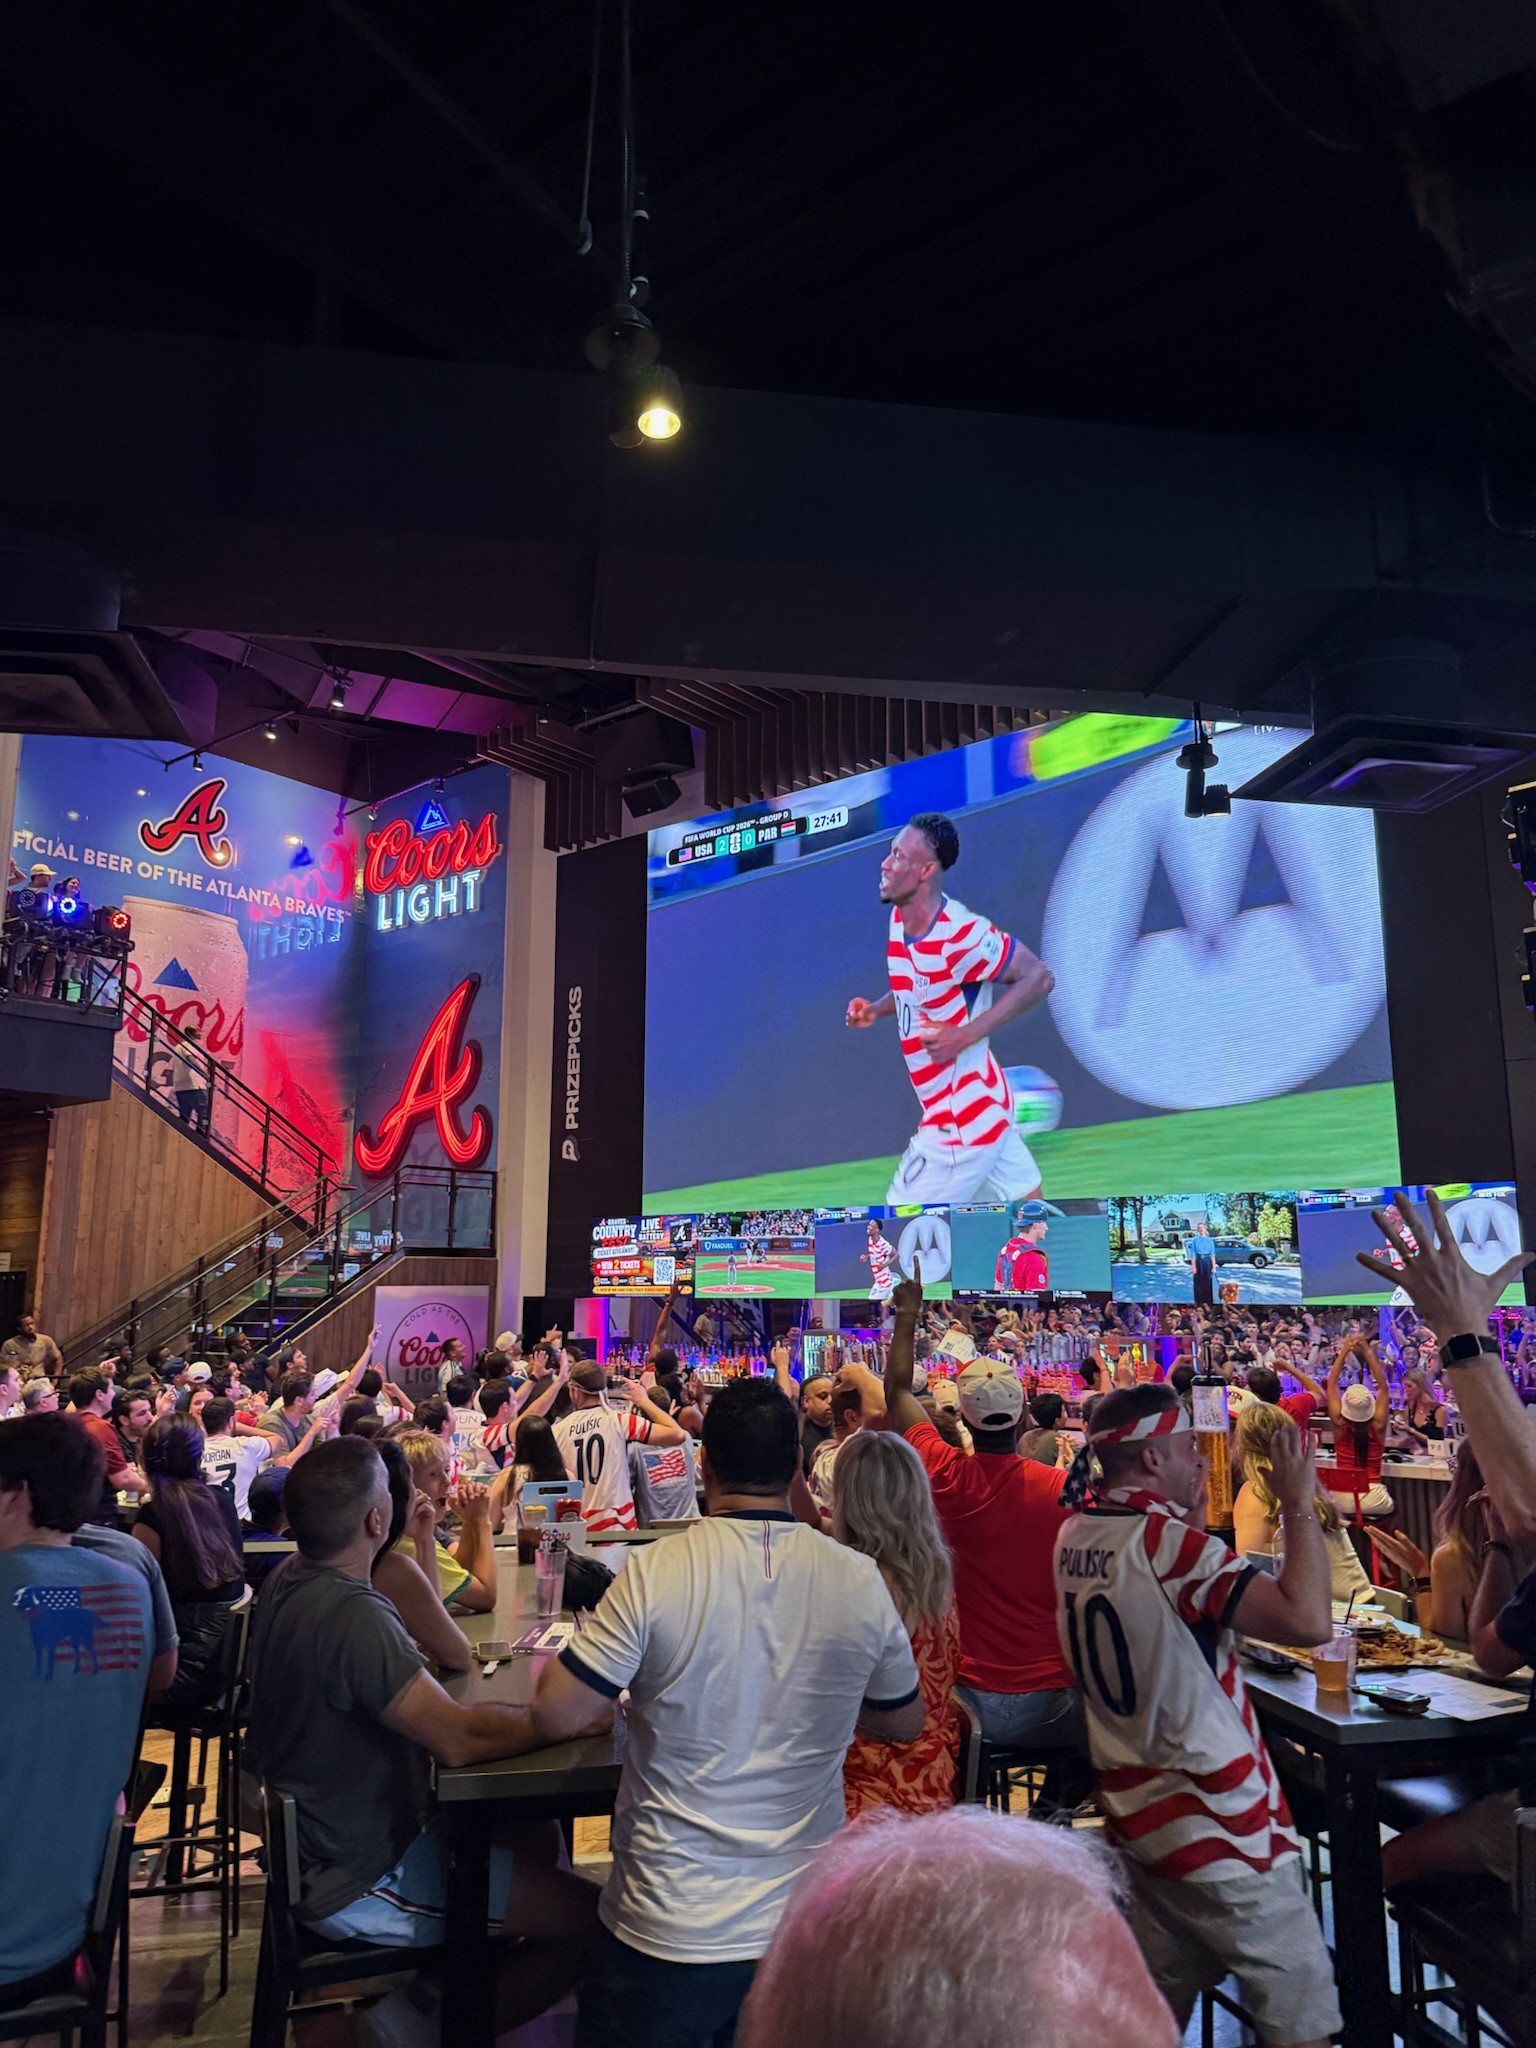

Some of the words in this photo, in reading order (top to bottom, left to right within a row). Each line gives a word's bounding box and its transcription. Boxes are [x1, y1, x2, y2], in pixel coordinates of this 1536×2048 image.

[684, 833, 699, 844] FIFA
[699, 828, 722, 841] WORLD
[722, 826, 735, 836] CUP
[759, 814, 782, 825] GROUP
[783, 812, 789, 820] D
[813, 812, 842, 828] 27:41
[364, 812, 503, 894] Coors
[695, 843, 713, 858] USA
[718, 840, 726, 852] 2
[745, 834, 752, 845] 0
[758, 826, 778, 842] PAR
[83, 848, 133, 875] BEER
[137, 861, 164, 881] OF
[167, 868, 203, 891] THE
[206, 879, 281, 909] ATLANTA
[377, 869, 487, 932] LIGHT
[565, 985, 583, 1130] PRIZEPICKS
[355, 972, 493, 1179] A
[592, 1224, 637, 1241] COUNTRY
[601, 1236, 630, 1248] FEST
[614, 1259, 619, 1270] 2
[404, 1308, 427, 1327] COLD
[431, 1306, 443, 1314] AS
[446, 1310, 460, 1325] THE
[399, 1336, 446, 1367] Coo
[404, 1367, 439, 1384] LIG
[569, 1417, 602, 1437] PULISIC
[574, 1433, 605, 1488] 10
[541, 1530, 571, 1542] Coors
[1060, 1547, 1114, 1579] PULISIC
[1065, 1591, 1136, 1717] 10
